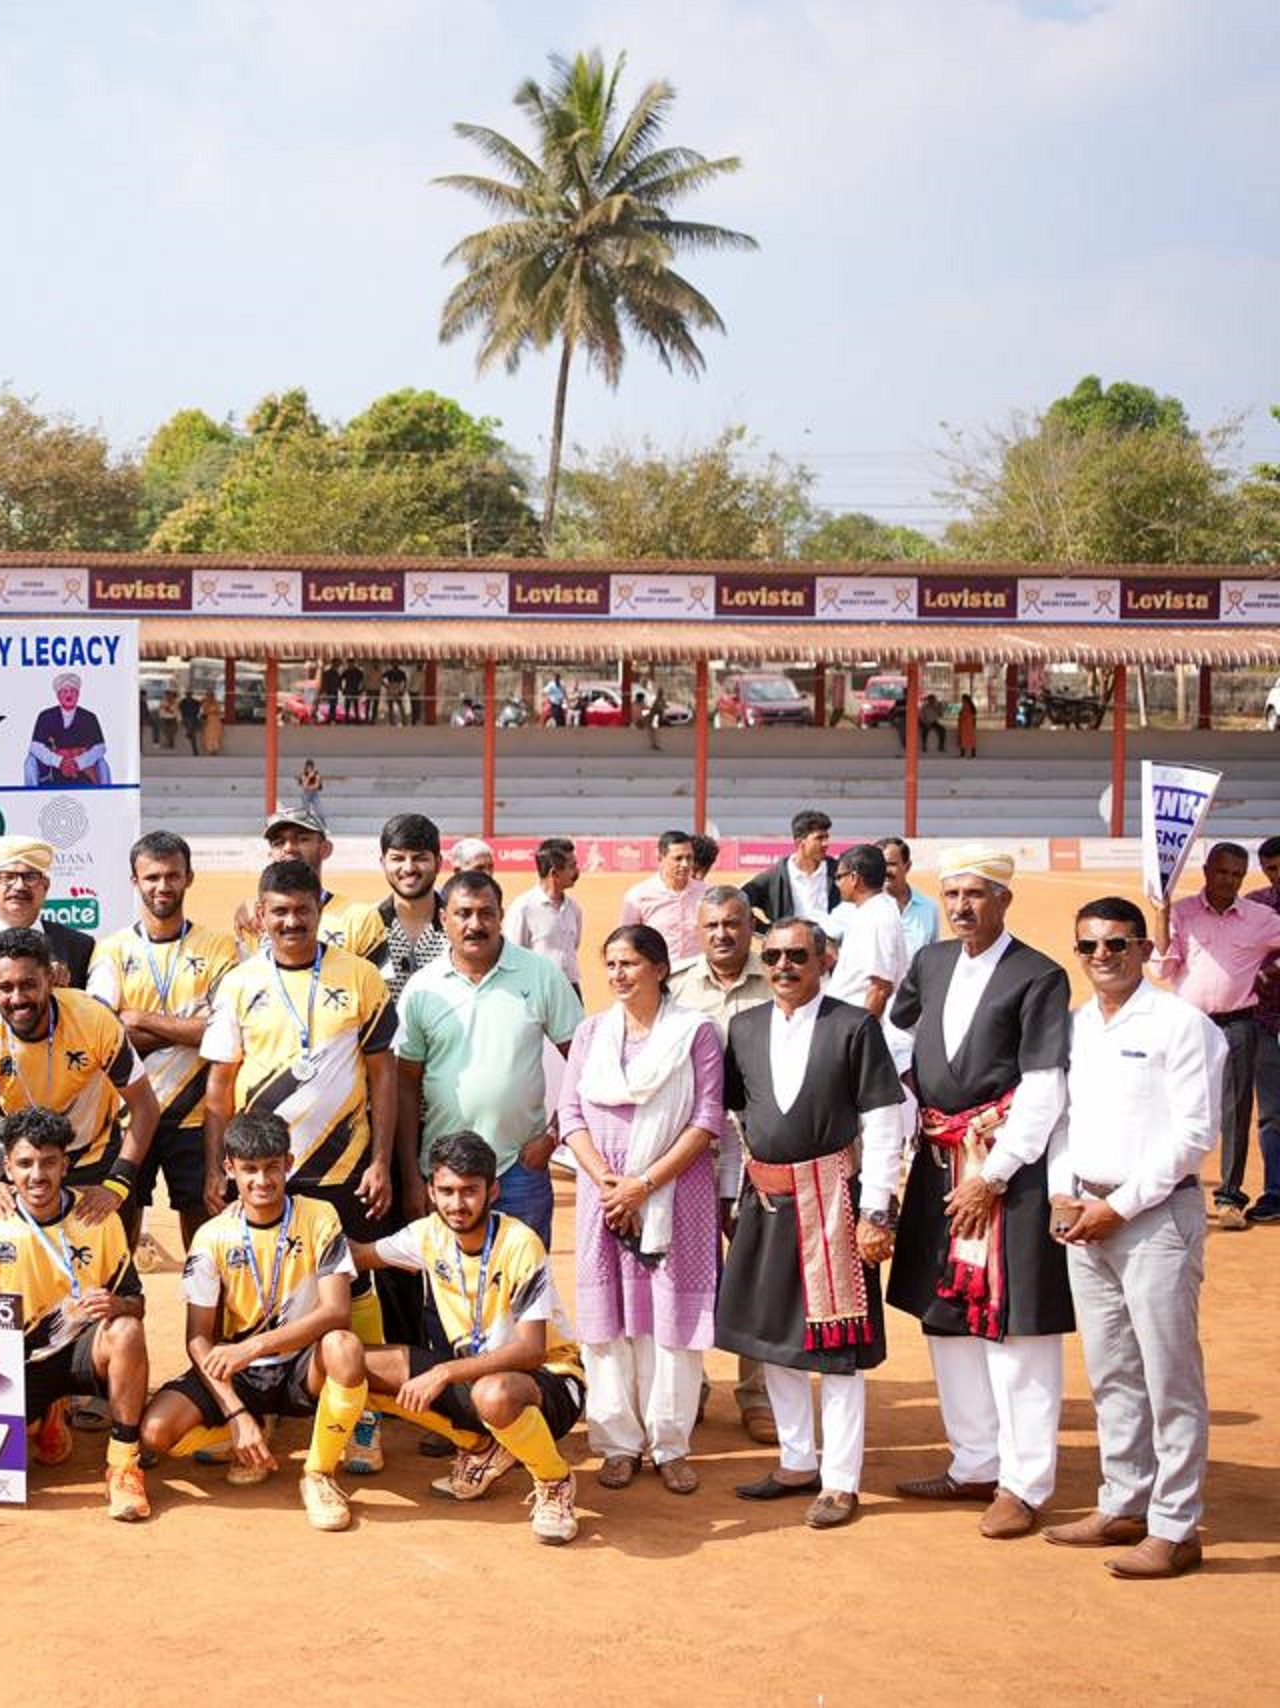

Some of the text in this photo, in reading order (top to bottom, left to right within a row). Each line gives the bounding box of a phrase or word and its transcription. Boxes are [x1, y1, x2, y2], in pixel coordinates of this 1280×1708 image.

[95, 580, 181, 600] Levista
[309, 582, 394, 602] Levista
[515, 584, 599, 604] Levista
[721, 586, 805, 606] Levista
[924, 588, 1007, 608] Levista
[1127, 590, 1209, 609] Levista
[21, 635, 120, 667] LEGACY
